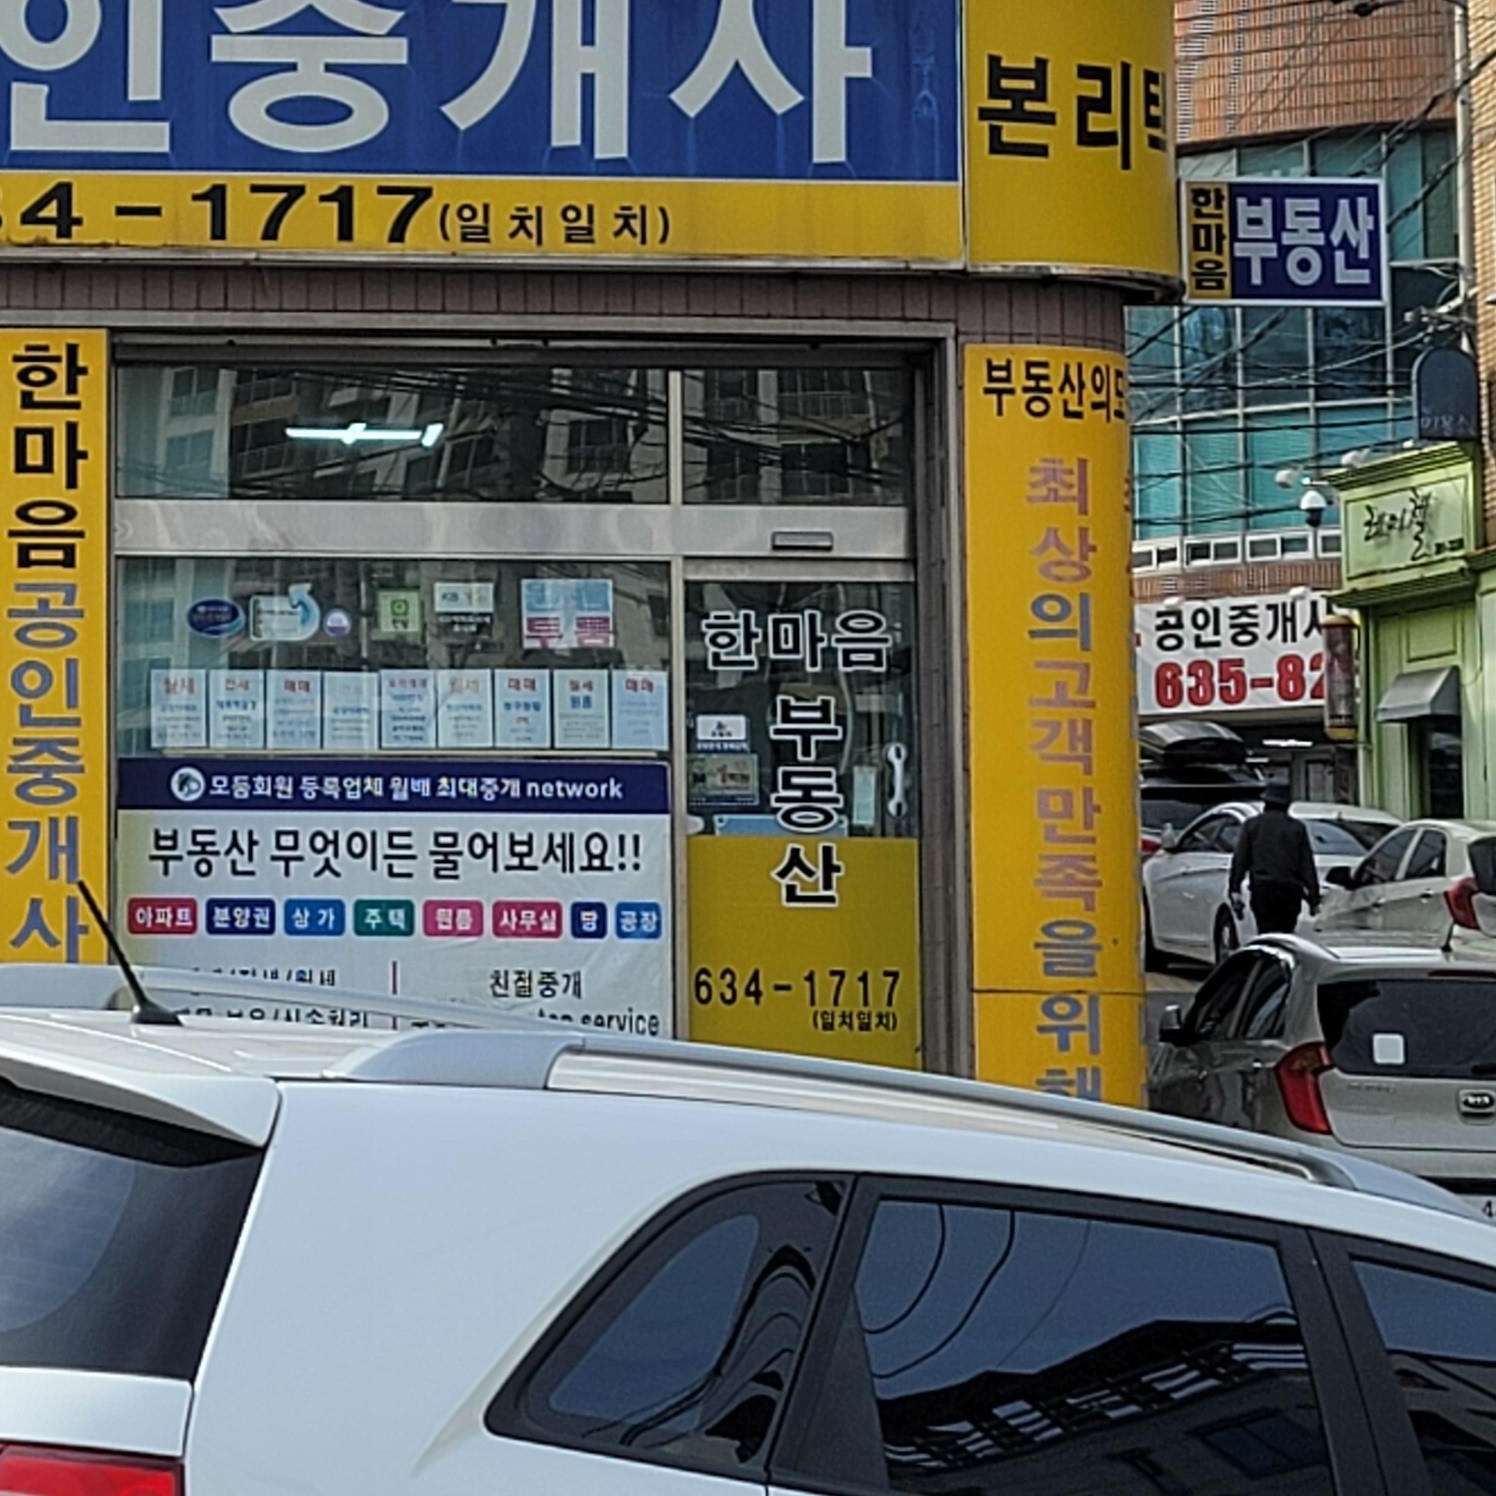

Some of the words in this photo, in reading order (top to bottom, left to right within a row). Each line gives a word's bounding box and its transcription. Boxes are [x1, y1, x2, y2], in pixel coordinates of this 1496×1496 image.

[1191, 187, 1228, 292] 한마음
[1234, 196, 1374, 286] 부동산
[702, 609, 892, 672] 한마음
[526, 776, 624, 799] network
[769, 696, 844, 908] 부동산
[149, 828, 259, 878] 부동산
[270, 830, 418, 880] 무엇이든
[429, 832, 642, 881] 물어보세요!!
[135, 906, 193, 928] 아파트
[499, 909, 558, 932] 사무실
[694, 967, 901, 1008] 634-1717
